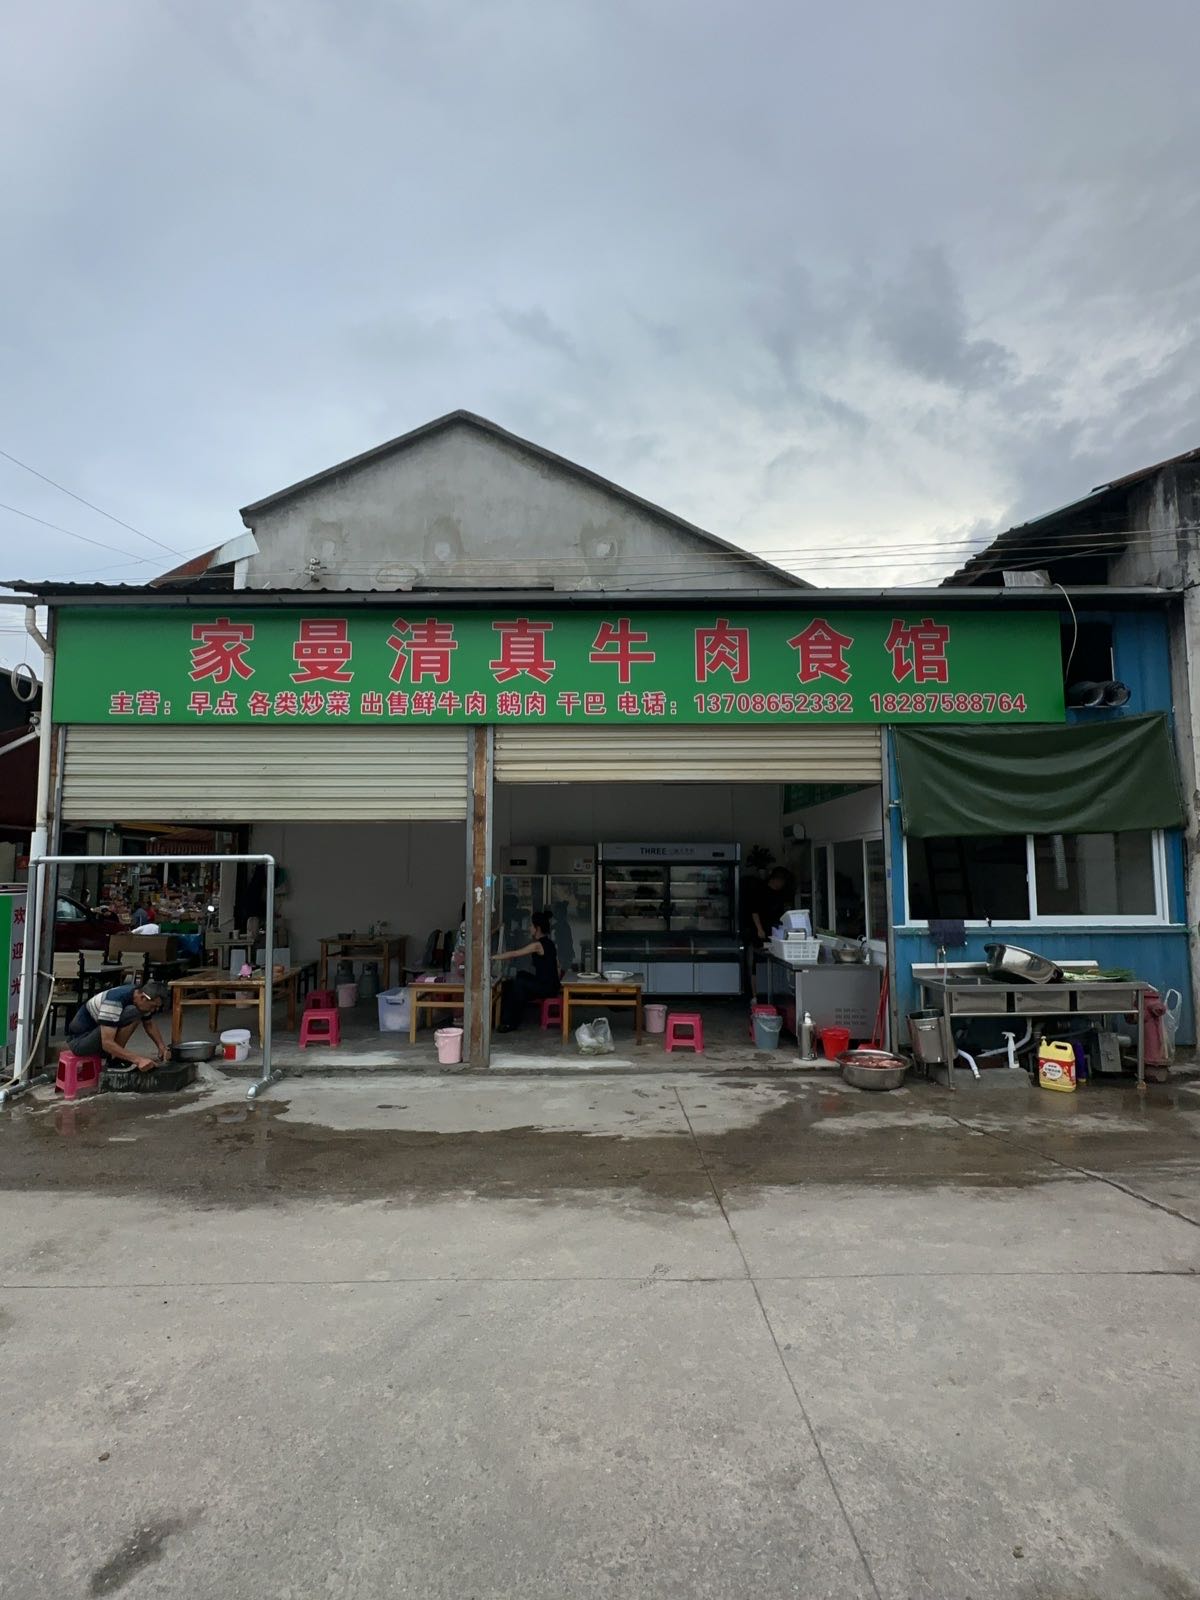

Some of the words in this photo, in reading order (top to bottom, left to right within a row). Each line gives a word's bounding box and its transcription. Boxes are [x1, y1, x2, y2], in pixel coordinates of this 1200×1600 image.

[188, 618, 951, 685] 家曼清真牛肉食馆
[187, 690, 238, 716] 早点
[248, 690, 350, 716] 各类炒菜
[360, 690, 487, 716] 出售鲜牛肉
[496, 690, 547, 716] 鹅肉
[557, 690, 607, 716] 干巴
[693, 692, 854, 714] 13708652332
[868, 692, 1028, 714] 18287588764
